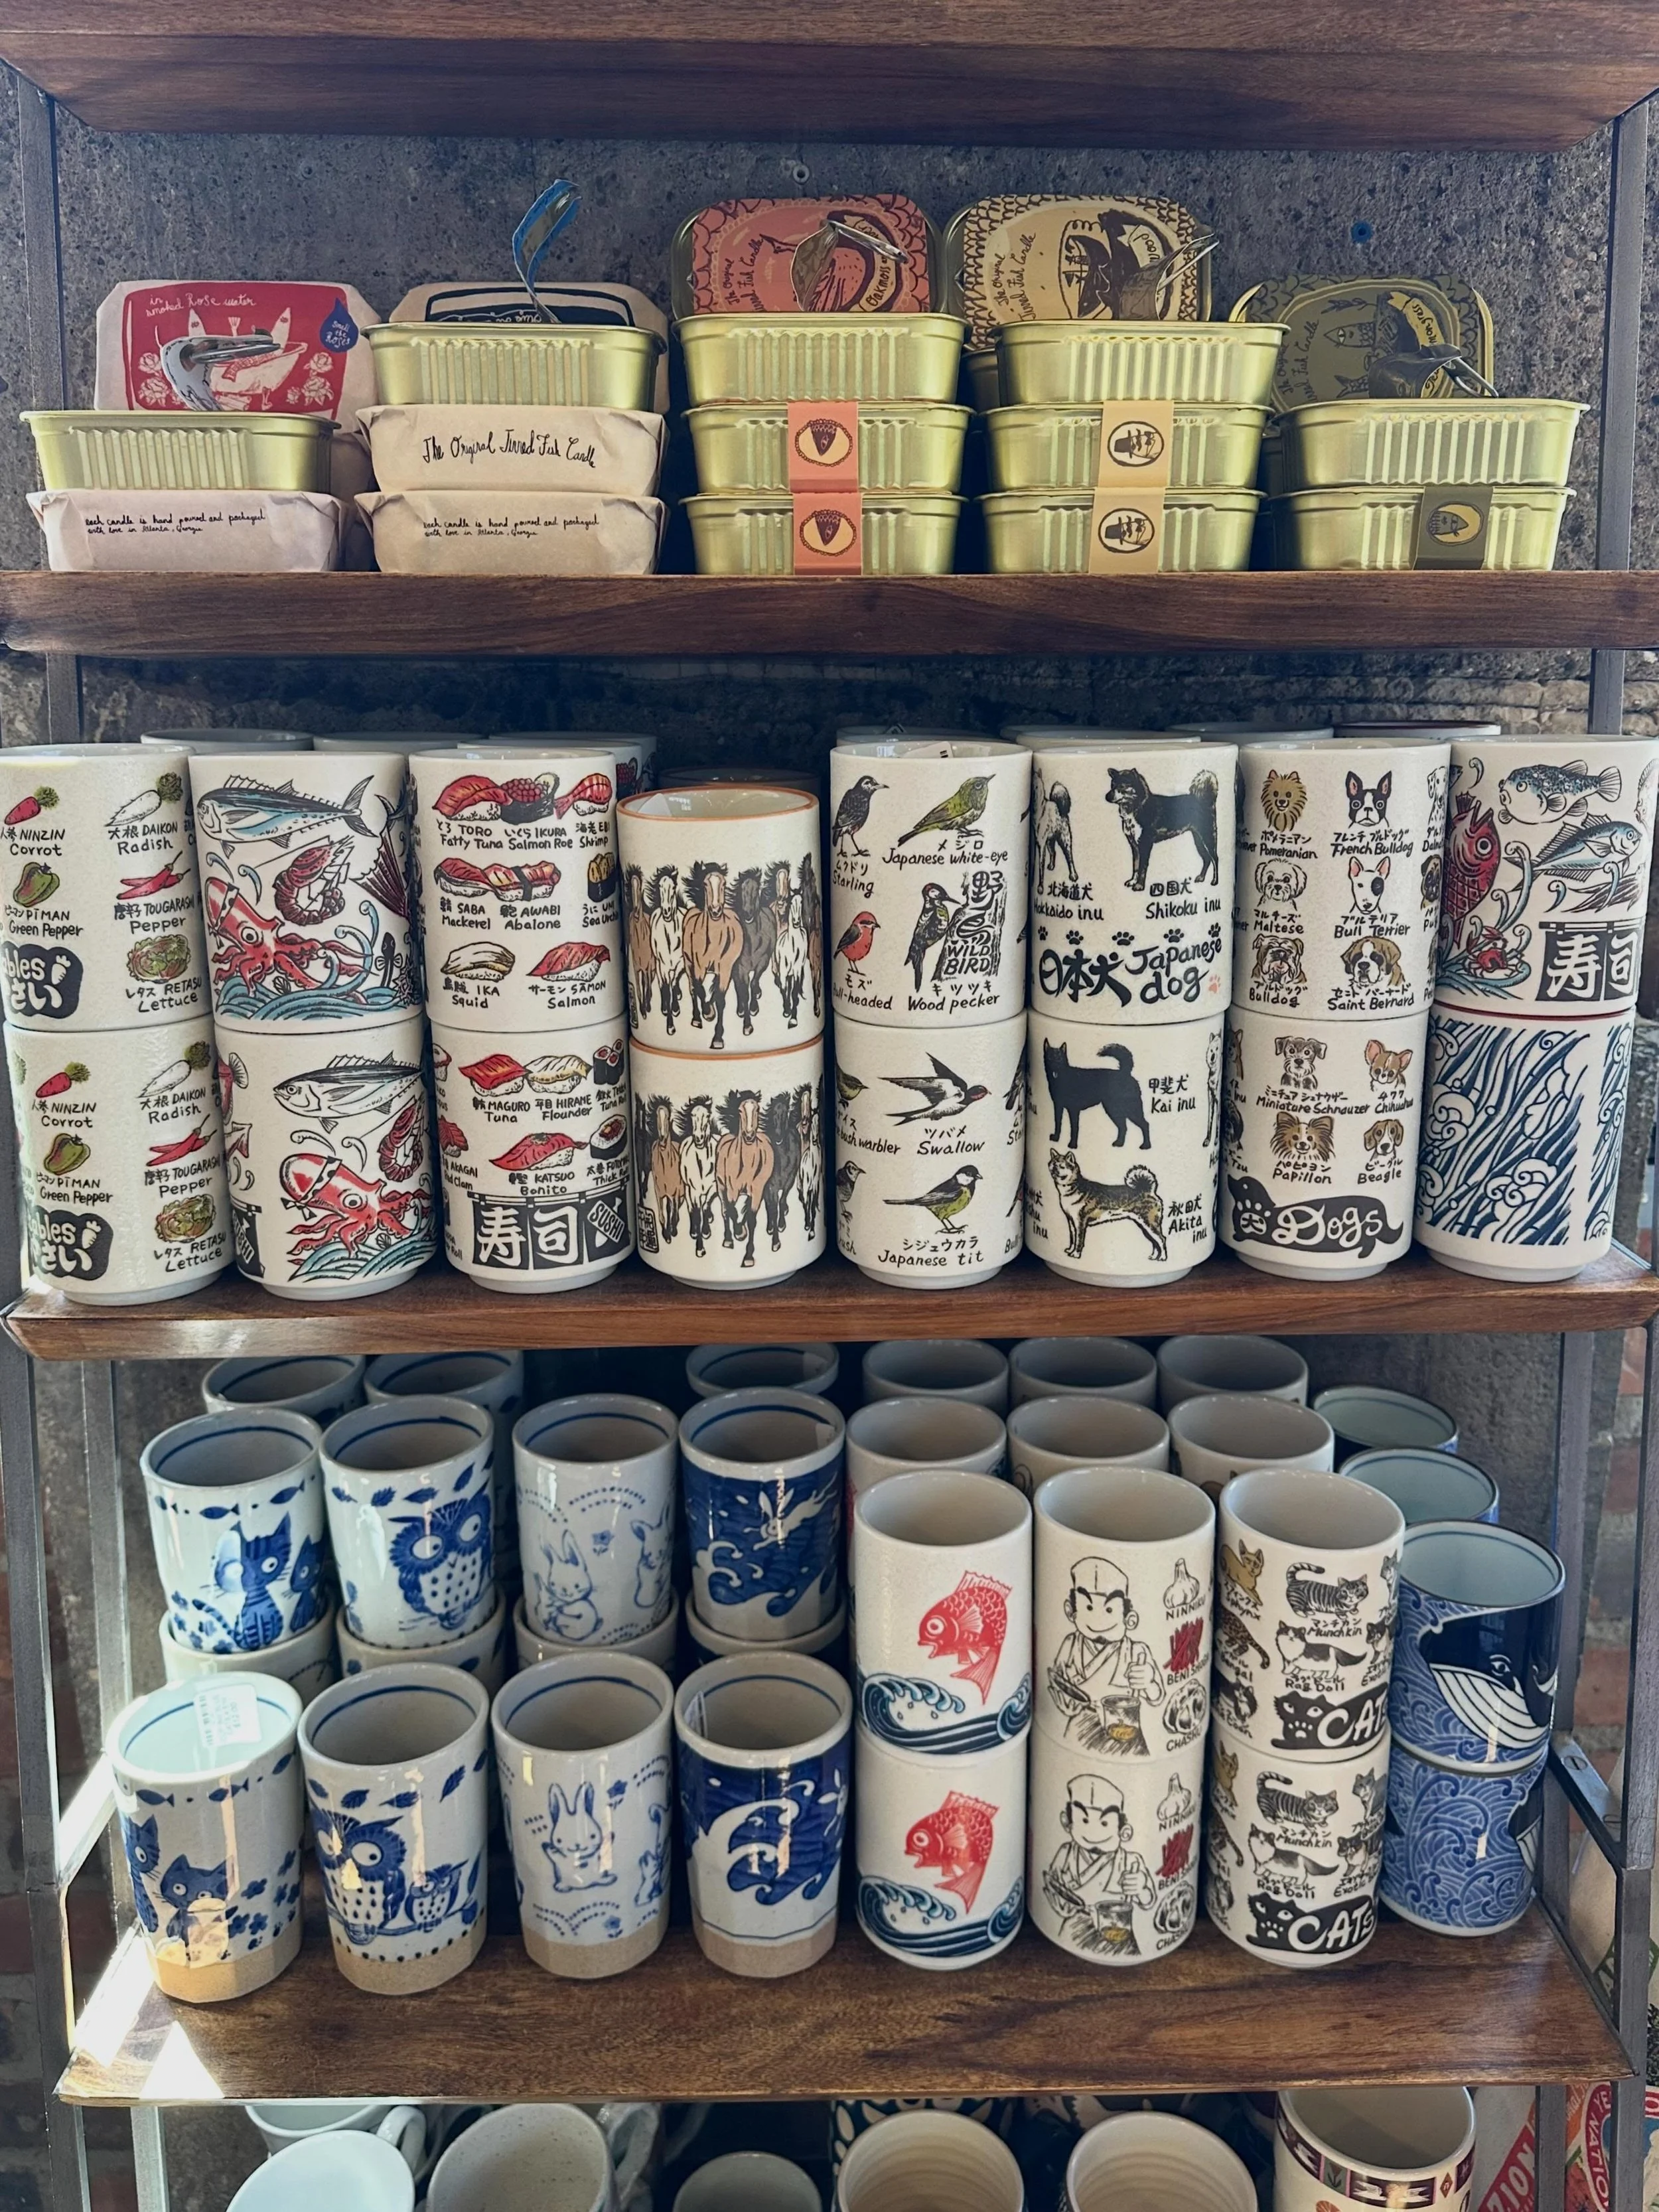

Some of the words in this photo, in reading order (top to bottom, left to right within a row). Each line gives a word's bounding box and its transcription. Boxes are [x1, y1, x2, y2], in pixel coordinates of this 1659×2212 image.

[739, 238, 764, 267] Candle
[1009, 232, 1037, 265] Candle
[723, 258, 735, 289] Original
[738, 269, 755, 287] Fish
[993, 252, 1006, 289] Original
[1009, 268, 1025, 289] Fish
[867, 265, 891, 307] Oakmoss
[146, 299, 184, 317] smoked
[223, 294, 256, 306] water
[422, 435, 444, 463] The
[451, 431, 495, 465] Original
[500, 429, 534, 453] Tinned
[537, 434, 561, 457] Fish
[566, 437, 595, 468] Candle
[85, 515, 104, 526] each
[107, 515, 133, 525] candle
[139, 515, 147, 524] is
[153, 514, 173, 524] hand
[179, 512, 206, 526] poured
[209, 512, 223, 522] and
[444, 518, 469, 528] candle
[475, 518, 482, 528] is
[489, 516, 508, 528] hand
[514, 516, 541, 529] poured
[543, 516, 557, 526] and
[20, 828, 65, 842] NINZIN
[108, 824, 139, 840] 大根
[142, 821, 178, 836] DAIKON
[459, 826, 492, 837] TORO
[504, 828, 532, 838] いくら
[536, 827, 567, 838] IKURA
[1260, 830, 1312, 846] ポメラニアン
[117, 839, 174, 855] Radish
[440, 834, 470, 851] Fatty
[474, 837, 504, 849] Tuna
[508, 838, 551, 850] Salmon
[554, 838, 573, 849] Roe
[579, 836, 609, 850] Shrimp
[1260, 842, 1318, 859] Pomeranian
[1331, 842, 1373, 857] French
[1374, 840, 1413, 857] Bulldog
[882, 847, 945, 871] Japanese
[950, 849, 1009, 865] white-eye
[832, 871, 875, 899] Starling
[1047, 881, 1094, 901] 北海道犬
[1149, 877, 1192, 897] 四国犬
[457, 904, 486, 916] SABA
[520, 906, 561, 917] AWABI
[1033, 897, 1074, 919] Hokkaido
[1078, 907, 1104, 921] inu
[1145, 900, 1198, 920] Shikoku
[1204, 897, 1222, 914] inu
[130, 916, 187, 935] Pepper
[442, 916, 491, 929] Mackerel
[504, 919, 561, 930] Abalone
[582, 913, 601, 928] Sea
[1253, 918, 1305, 935] Maltese
[9, 919, 40, 935] Green
[42, 921, 84, 940] Pepper
[1334, 925, 1362, 938] Bull
[1368, 923, 1411, 937] Terrier
[947, 944, 993, 958] WILD
[1125, 936, 1222, 977] Japanese
[943, 958, 991, 976] BIRD
[1547, 930, 1638, 999] 寿司
[1039, 948, 1132, 1007] 日本犬
[1140, 967, 1210, 1003] dog
[476, 985, 500, 996] IKA
[528, 985, 567, 995] サーモン
[1249, 986, 1301, 1007] Bulldog
[451, 995, 488, 1009] Squid
[547, 995, 596, 1009] Salmon
[907, 997, 944, 1011] Wood
[949, 994, 1001, 1014] pecker
[1327, 997, 1366, 1012] Saint
[1369, 995, 1415, 1009] Bernard
[1148, 1074, 1189, 1095] 甲斐犬
[140, 1095, 169, 1110] 大根
[172, 1087, 206, 1104] DAIKON
[488, 1100, 531, 1112] MAGURO
[555, 1094, 592, 1109] HIRAME
[600, 1097, 618, 1112] Tuna
[1151, 1098, 1172, 1114] Kai
[1177, 1096, 1196, 1112] inu
[1256, 1096, 1311, 1114] Miniature
[1313, 1102, 1370, 1116] Schnauzer
[51, 1102, 96, 1114] NINZIN
[149, 1102, 202, 1125] Radish
[541, 1106, 593, 1122] Flounder
[484, 1111, 518, 1124] Tuna
[924, 1126, 967, 1139] ツバメ
[857, 1137, 902, 1155] warbler
[916, 1140, 986, 1155] Swallow
[450, 1161, 478, 1178] AKAGAI
[534, 1171, 575, 1183] KATSUO
[593, 1169, 617, 1186] Thick
[1272, 1169, 1333, 1184] Papillon
[1357, 1169, 1402, 1184] Beagle
[159, 1176, 213, 1198] Pepper
[520, 1185, 567, 1196] Bonito
[40, 1186, 70, 1201] Green
[74, 1191, 113, 1207] Pepper
[1168, 1193, 1202, 1218] 秋田犬
[589, 1202, 625, 1239] SUSHI
[1168, 1217, 1203, 1236] Akita
[1271, 1203, 1383, 1248] Dogs
[190, 1231, 227, 1255] RETASU
[476, 1205, 579, 1266] 寿司
[902, 1236, 979, 1252] シジュウカラ
[1192, 1228, 1207, 1244] inu
[165, 1247, 224, 1273] Lettuce
[878, 1249, 948, 1267] Japanese
[958, 1252, 985, 1266] tit
[1307, 1626, 1362, 1639] Munchkin
[1285, 1678, 1311, 1692] Rag
[1315, 1682, 1345, 1692] Doll
[1276, 1834, 1333, 1848] Munchkin
[1257, 1880, 1281, 1895] Rag
[1285, 1889, 1315, 1899] Doll
[1287, 1901, 1374, 1952] CATS
